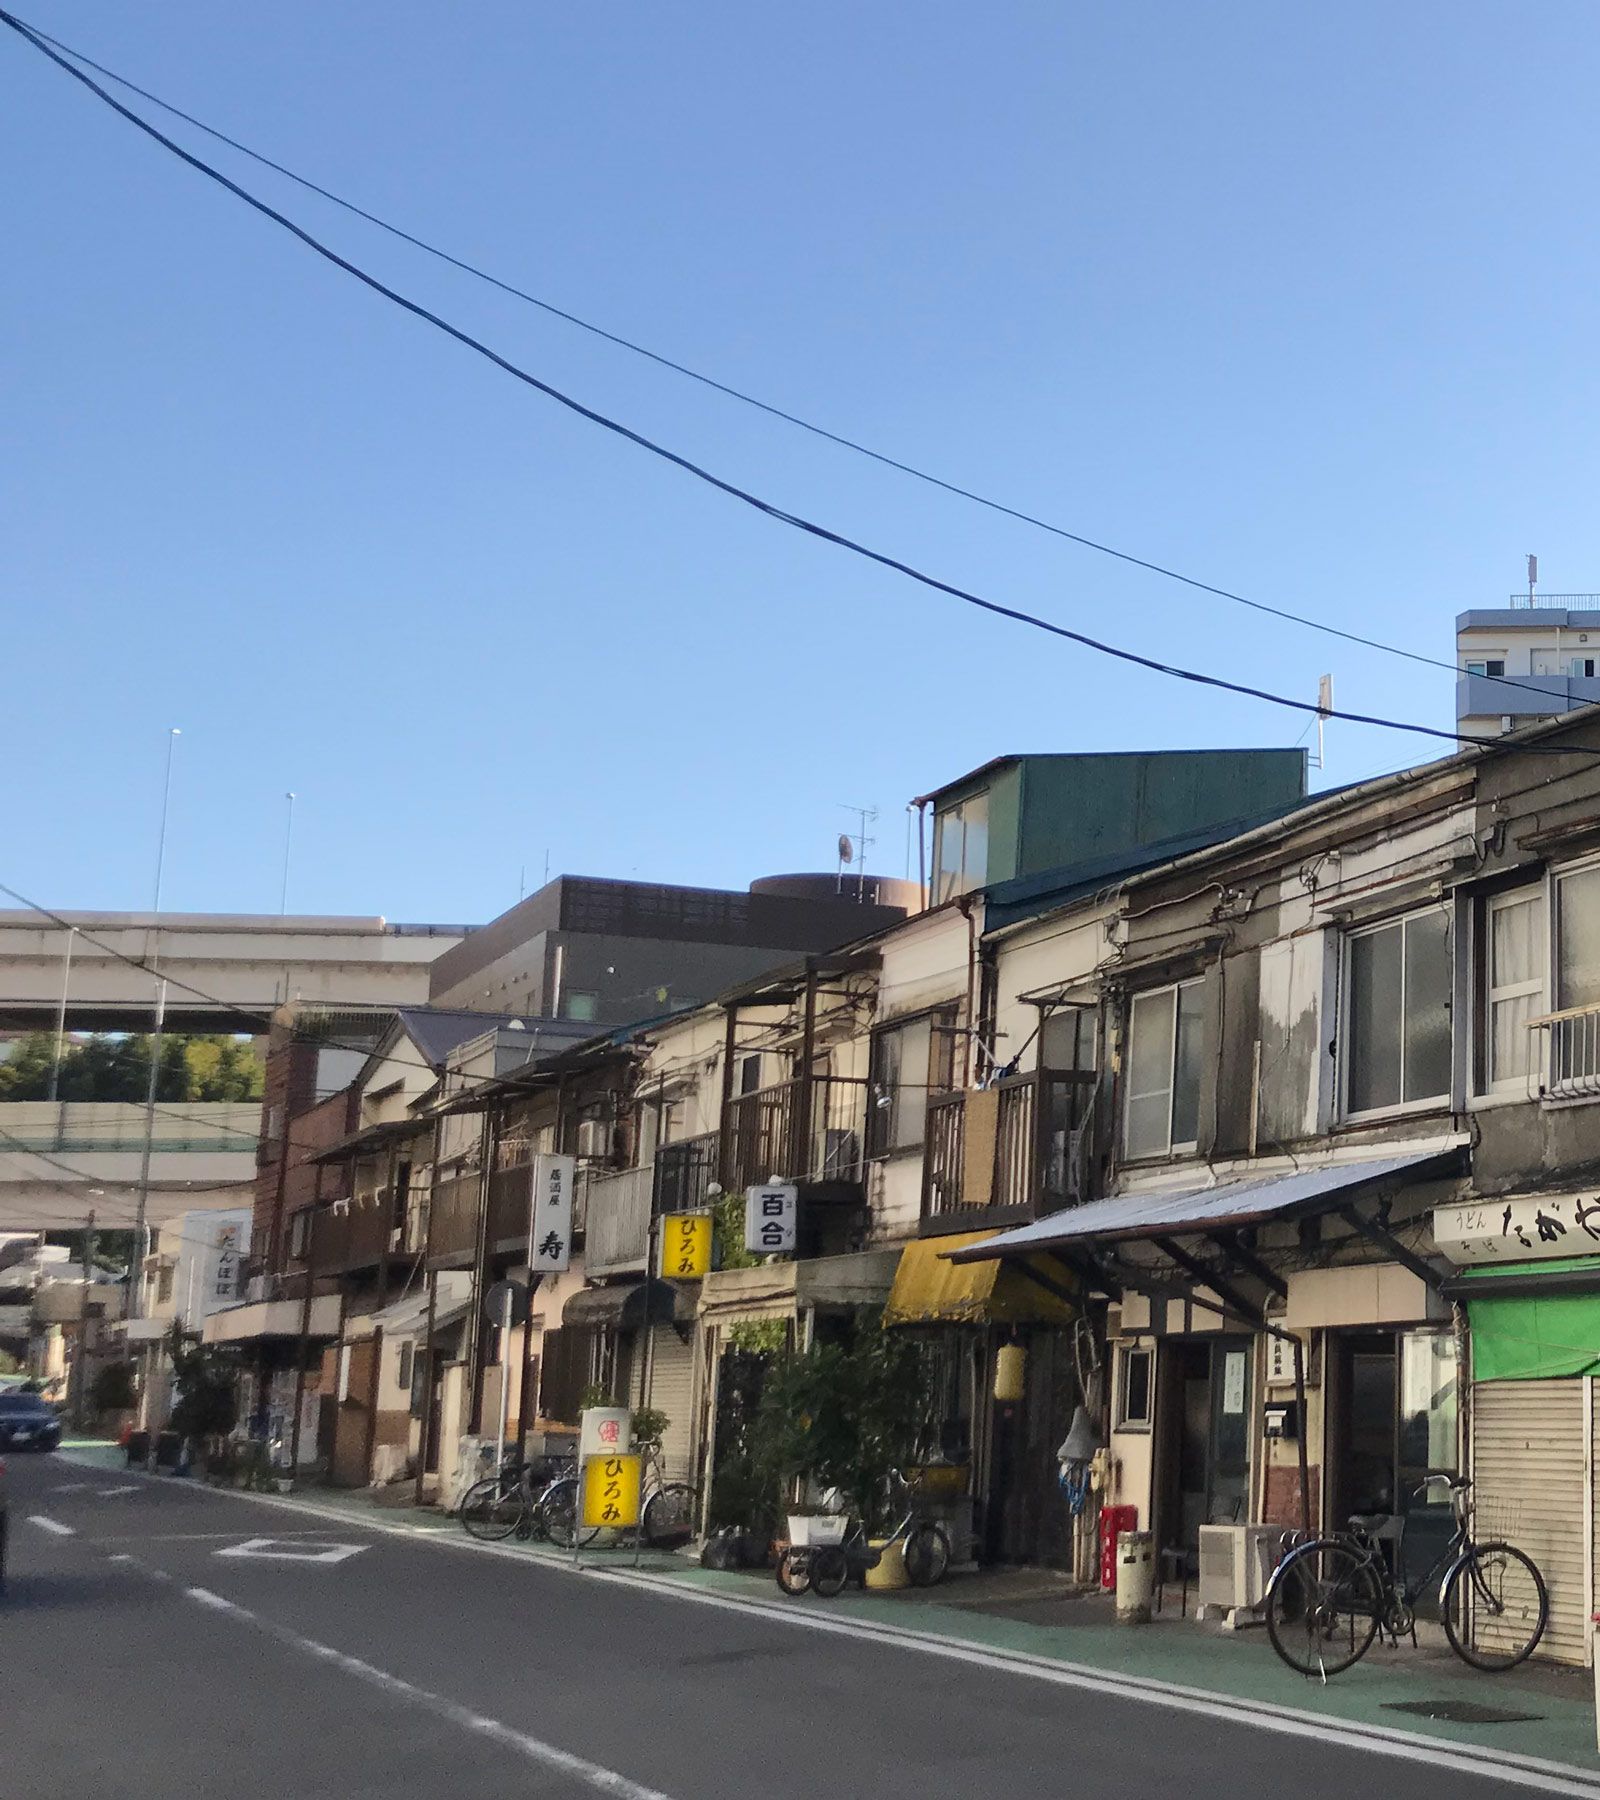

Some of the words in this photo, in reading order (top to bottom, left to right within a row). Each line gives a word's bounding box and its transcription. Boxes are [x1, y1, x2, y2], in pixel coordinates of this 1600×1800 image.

[539, 1230, 564, 1260] 寿
[761, 1194, 785, 1245] 百合
[1456, 1211, 1486, 1232] うどん
[679, 1220, 697, 1273] ひろみ
[601, 1458, 623, 1520] ひろみ
